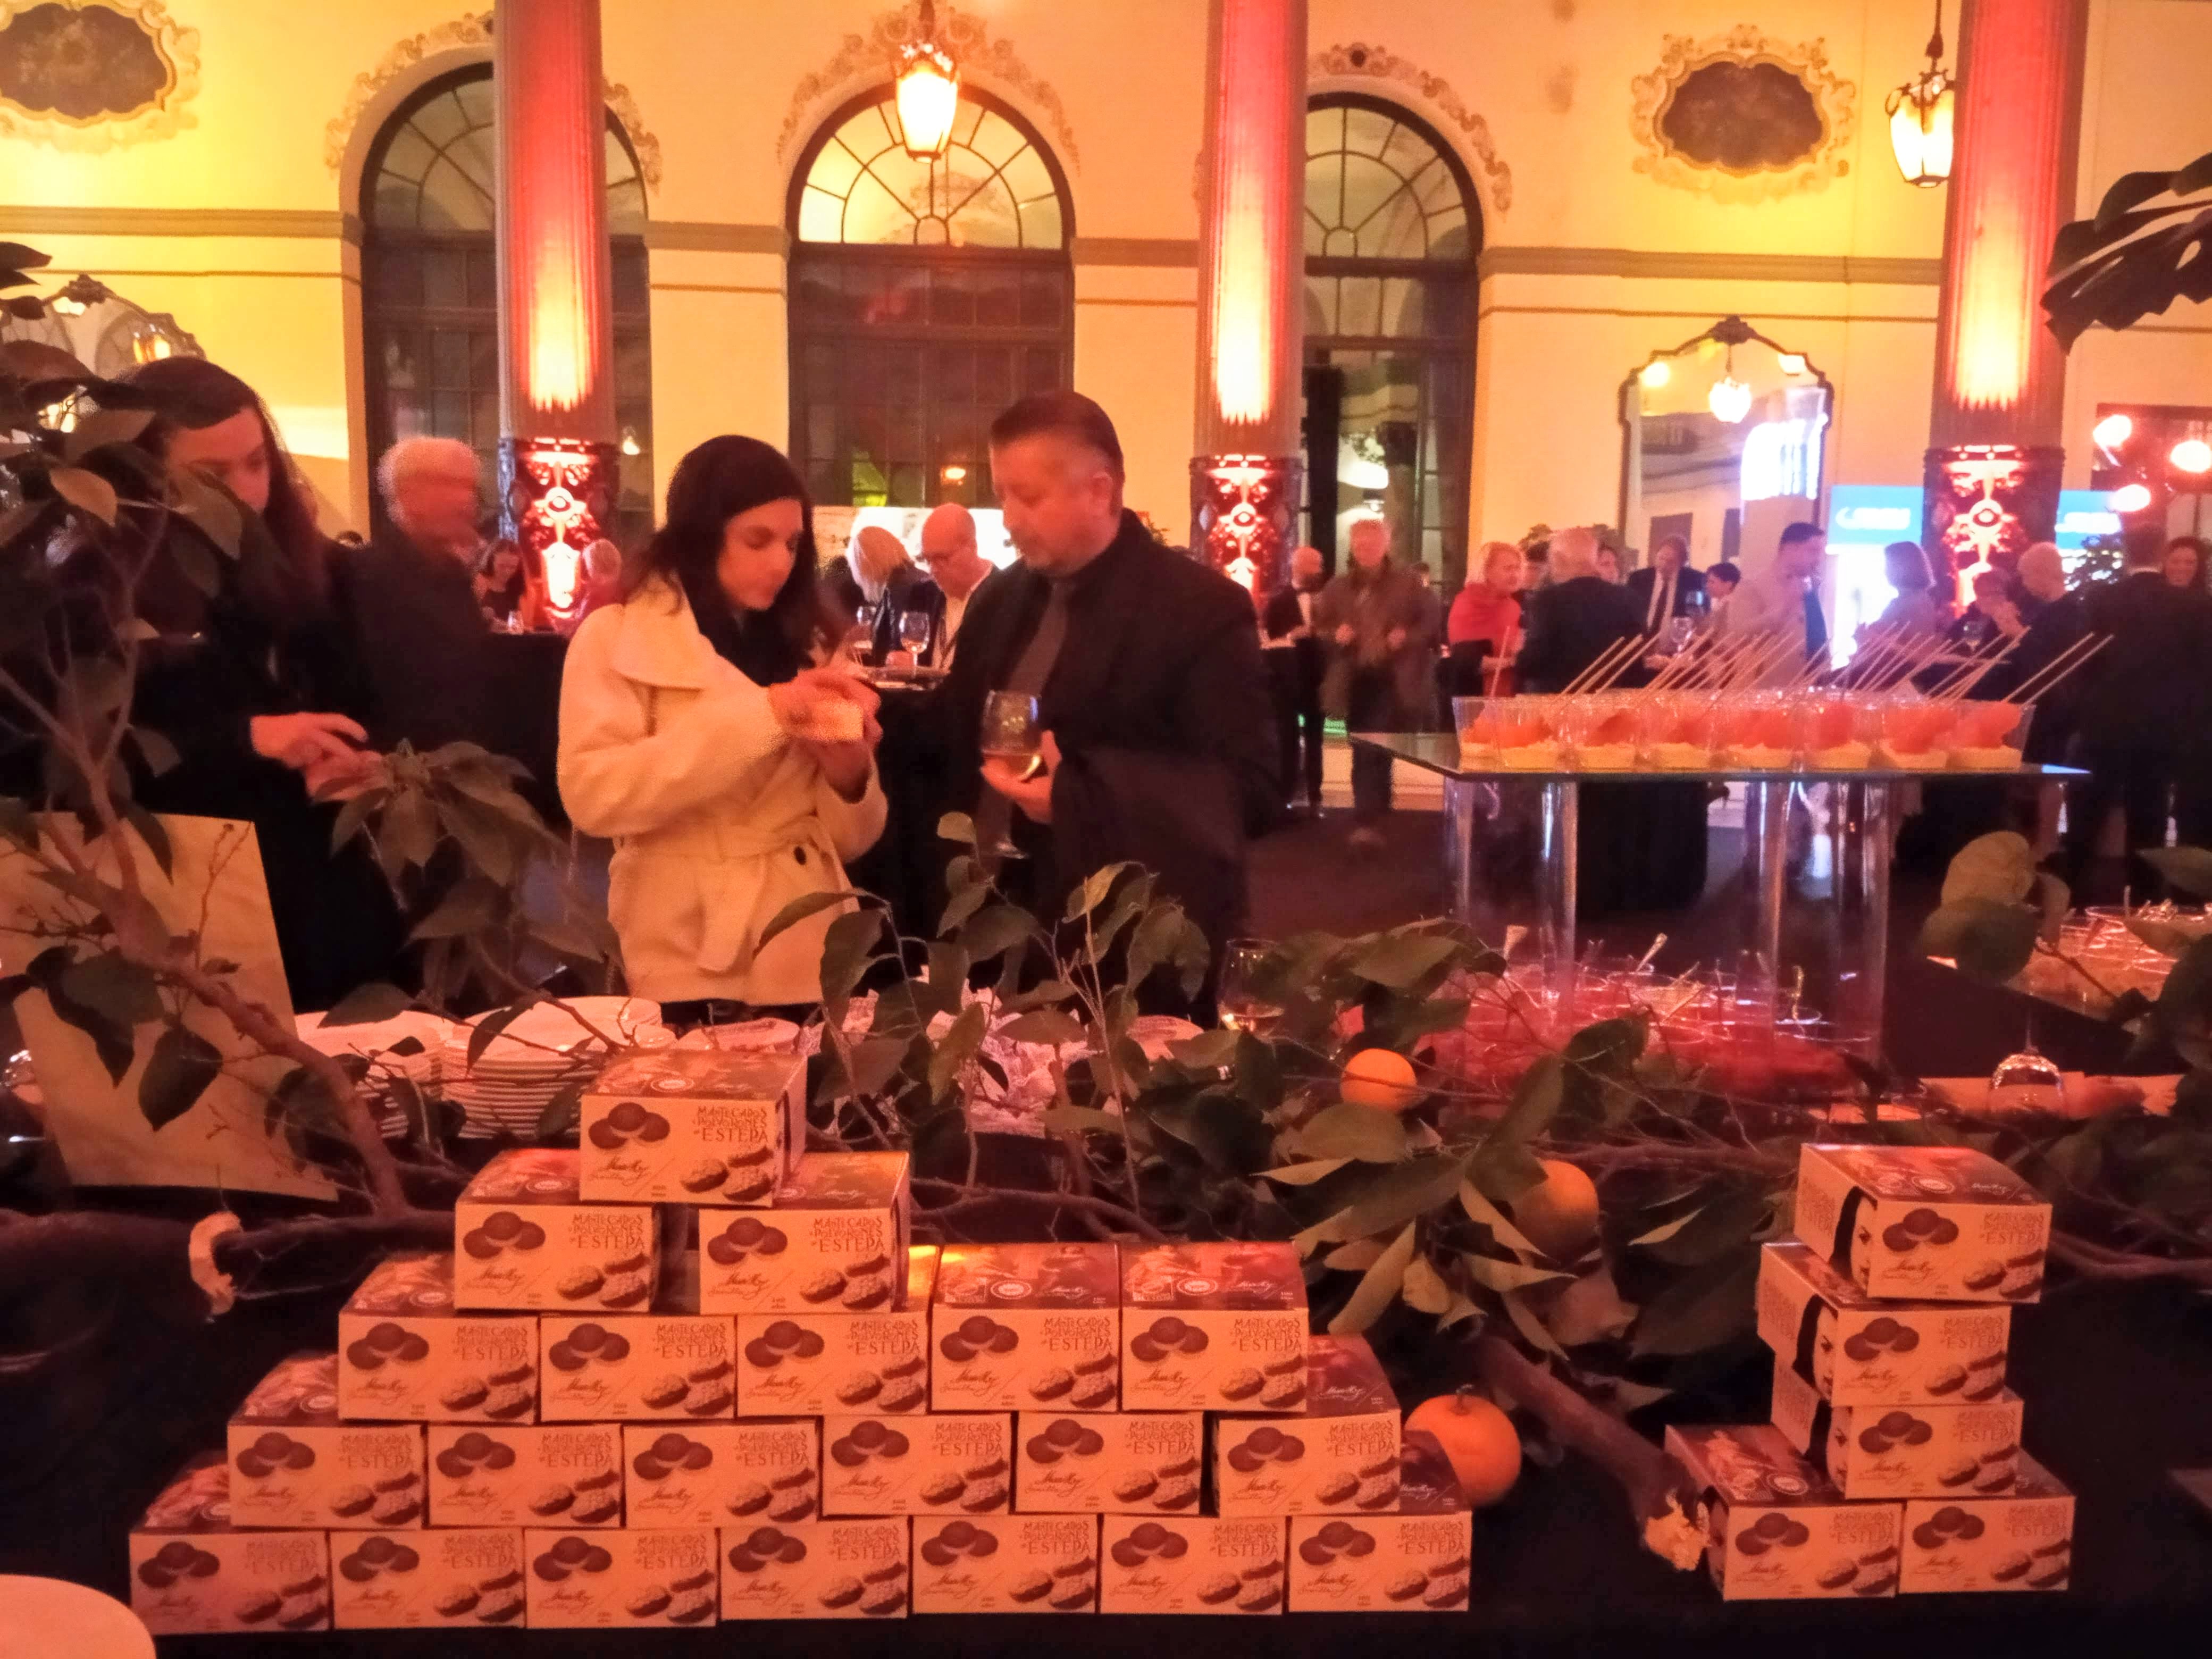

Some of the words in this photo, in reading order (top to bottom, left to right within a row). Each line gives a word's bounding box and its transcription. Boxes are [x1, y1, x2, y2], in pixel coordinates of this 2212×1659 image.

[702, 1128, 768, 1142] ESTEPA
[579, 1235, 644, 1249] ESTEPA
[820, 1237, 884, 1252] ESTEPA
[663, 1343, 727, 1358] ESTEPA
[856, 1340, 919, 1354] ESTEPA
[1050, 1337, 1112, 1350] ESTEPA
[1239, 1338, 1302, 1351] ESTEPA
[462, 1347, 529, 1360] ESTEPA
[941, 1442, 1003, 1455] ESTEPA
[1134, 1441, 1195, 1453] ESTEPA
[1335, 1440, 1395, 1456] ESTEPA
[1029, 1540, 1090, 1554] ESTEPA
